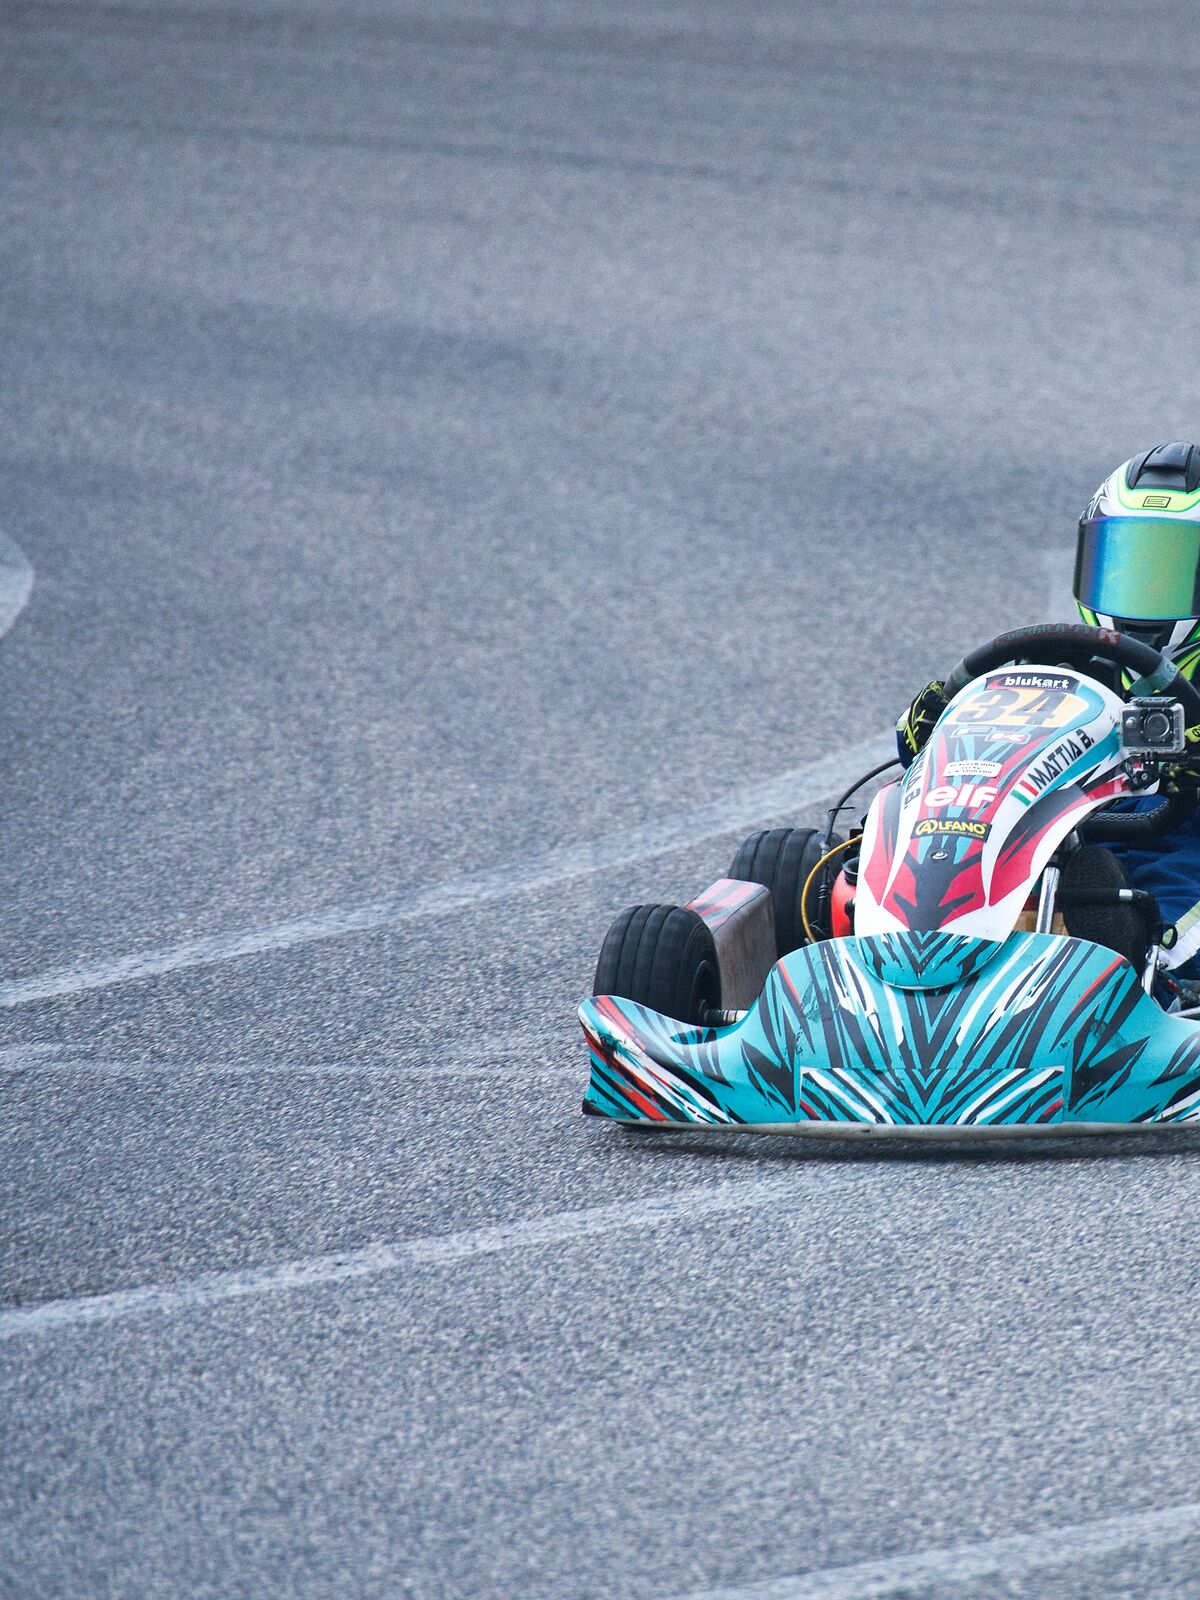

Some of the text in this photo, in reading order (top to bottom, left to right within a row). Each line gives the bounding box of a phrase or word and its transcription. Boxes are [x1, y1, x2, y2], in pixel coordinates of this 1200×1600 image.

[1004, 676, 1070, 688] blukart
[954, 689, 1068, 726] 34
[1027, 738, 1084, 791] MATTIA
[924, 783, 999, 808] elf
[915, 819, 986, 836] ALFANO
